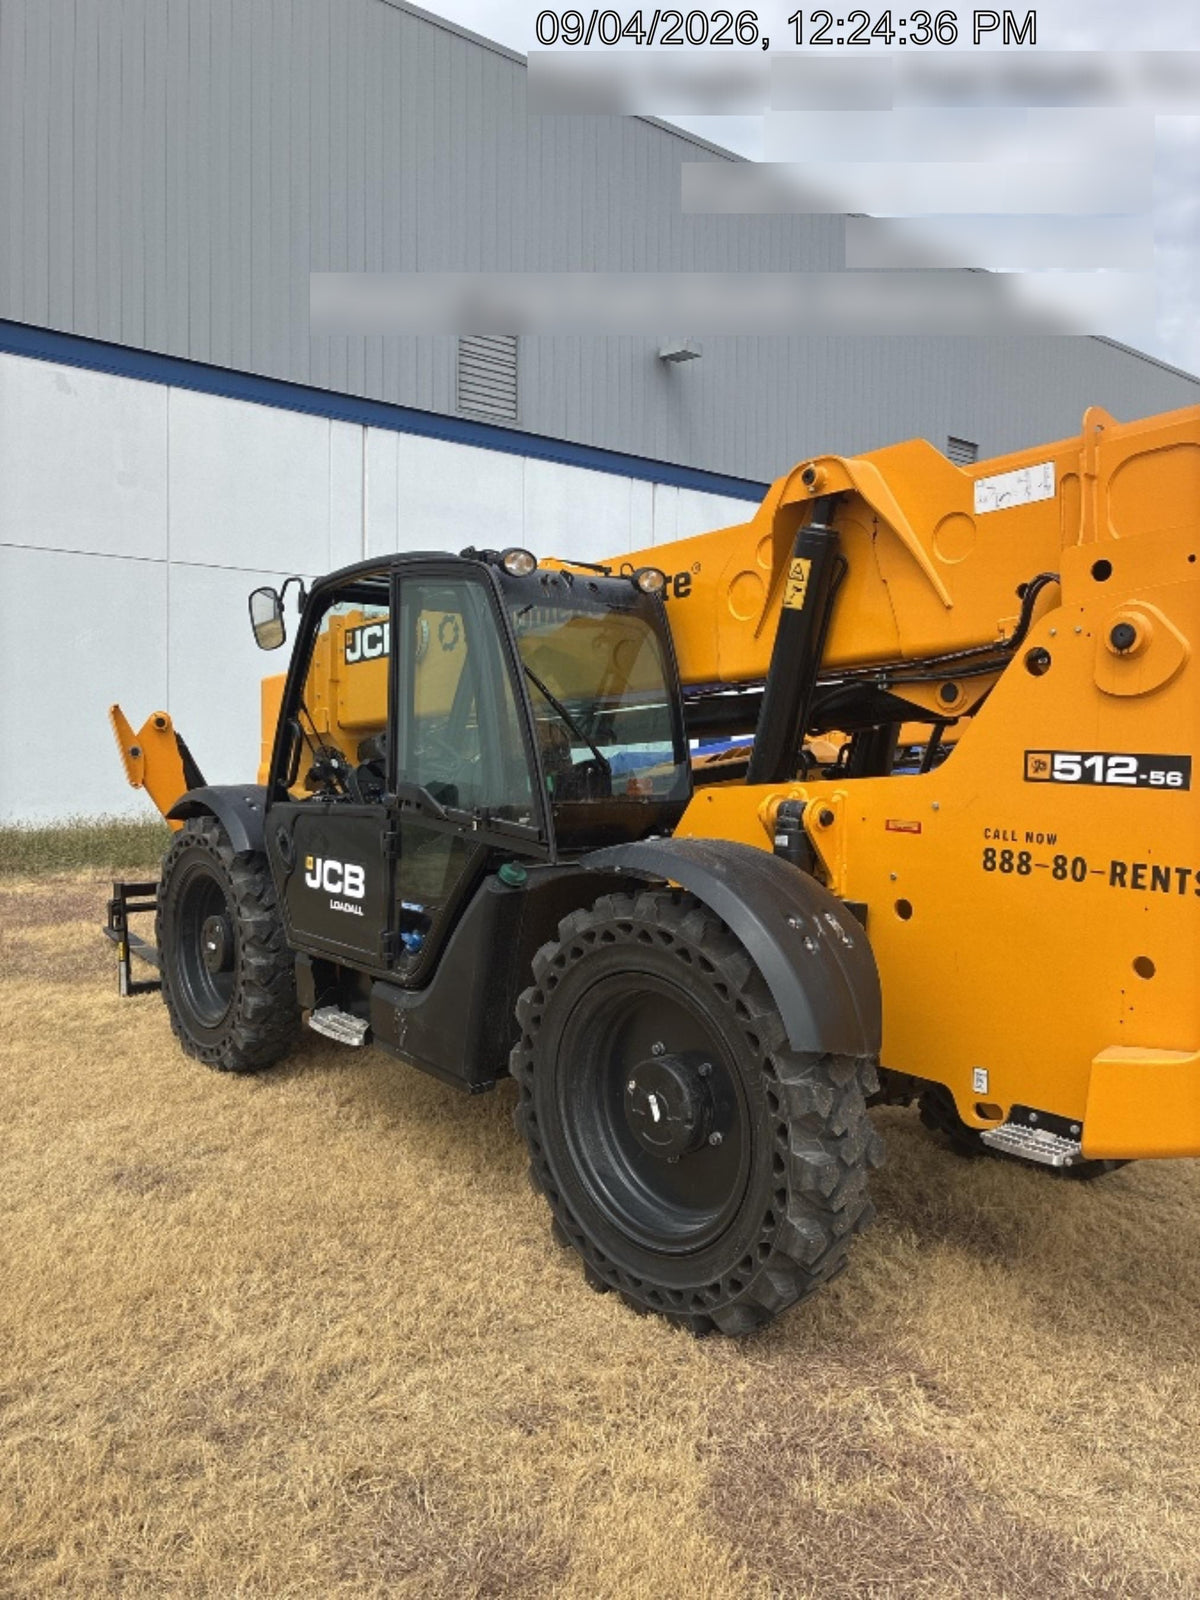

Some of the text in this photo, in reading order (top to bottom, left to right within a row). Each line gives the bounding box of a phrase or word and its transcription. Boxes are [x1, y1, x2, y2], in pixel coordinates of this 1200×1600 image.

[346, 622, 390, 662] JC
[1052, 753, 1184, 787] 512-56
[984, 827, 1057, 846] CALL NOW
[305, 857, 365, 899] JCB
[329, 899, 364, 917] LOADALL
